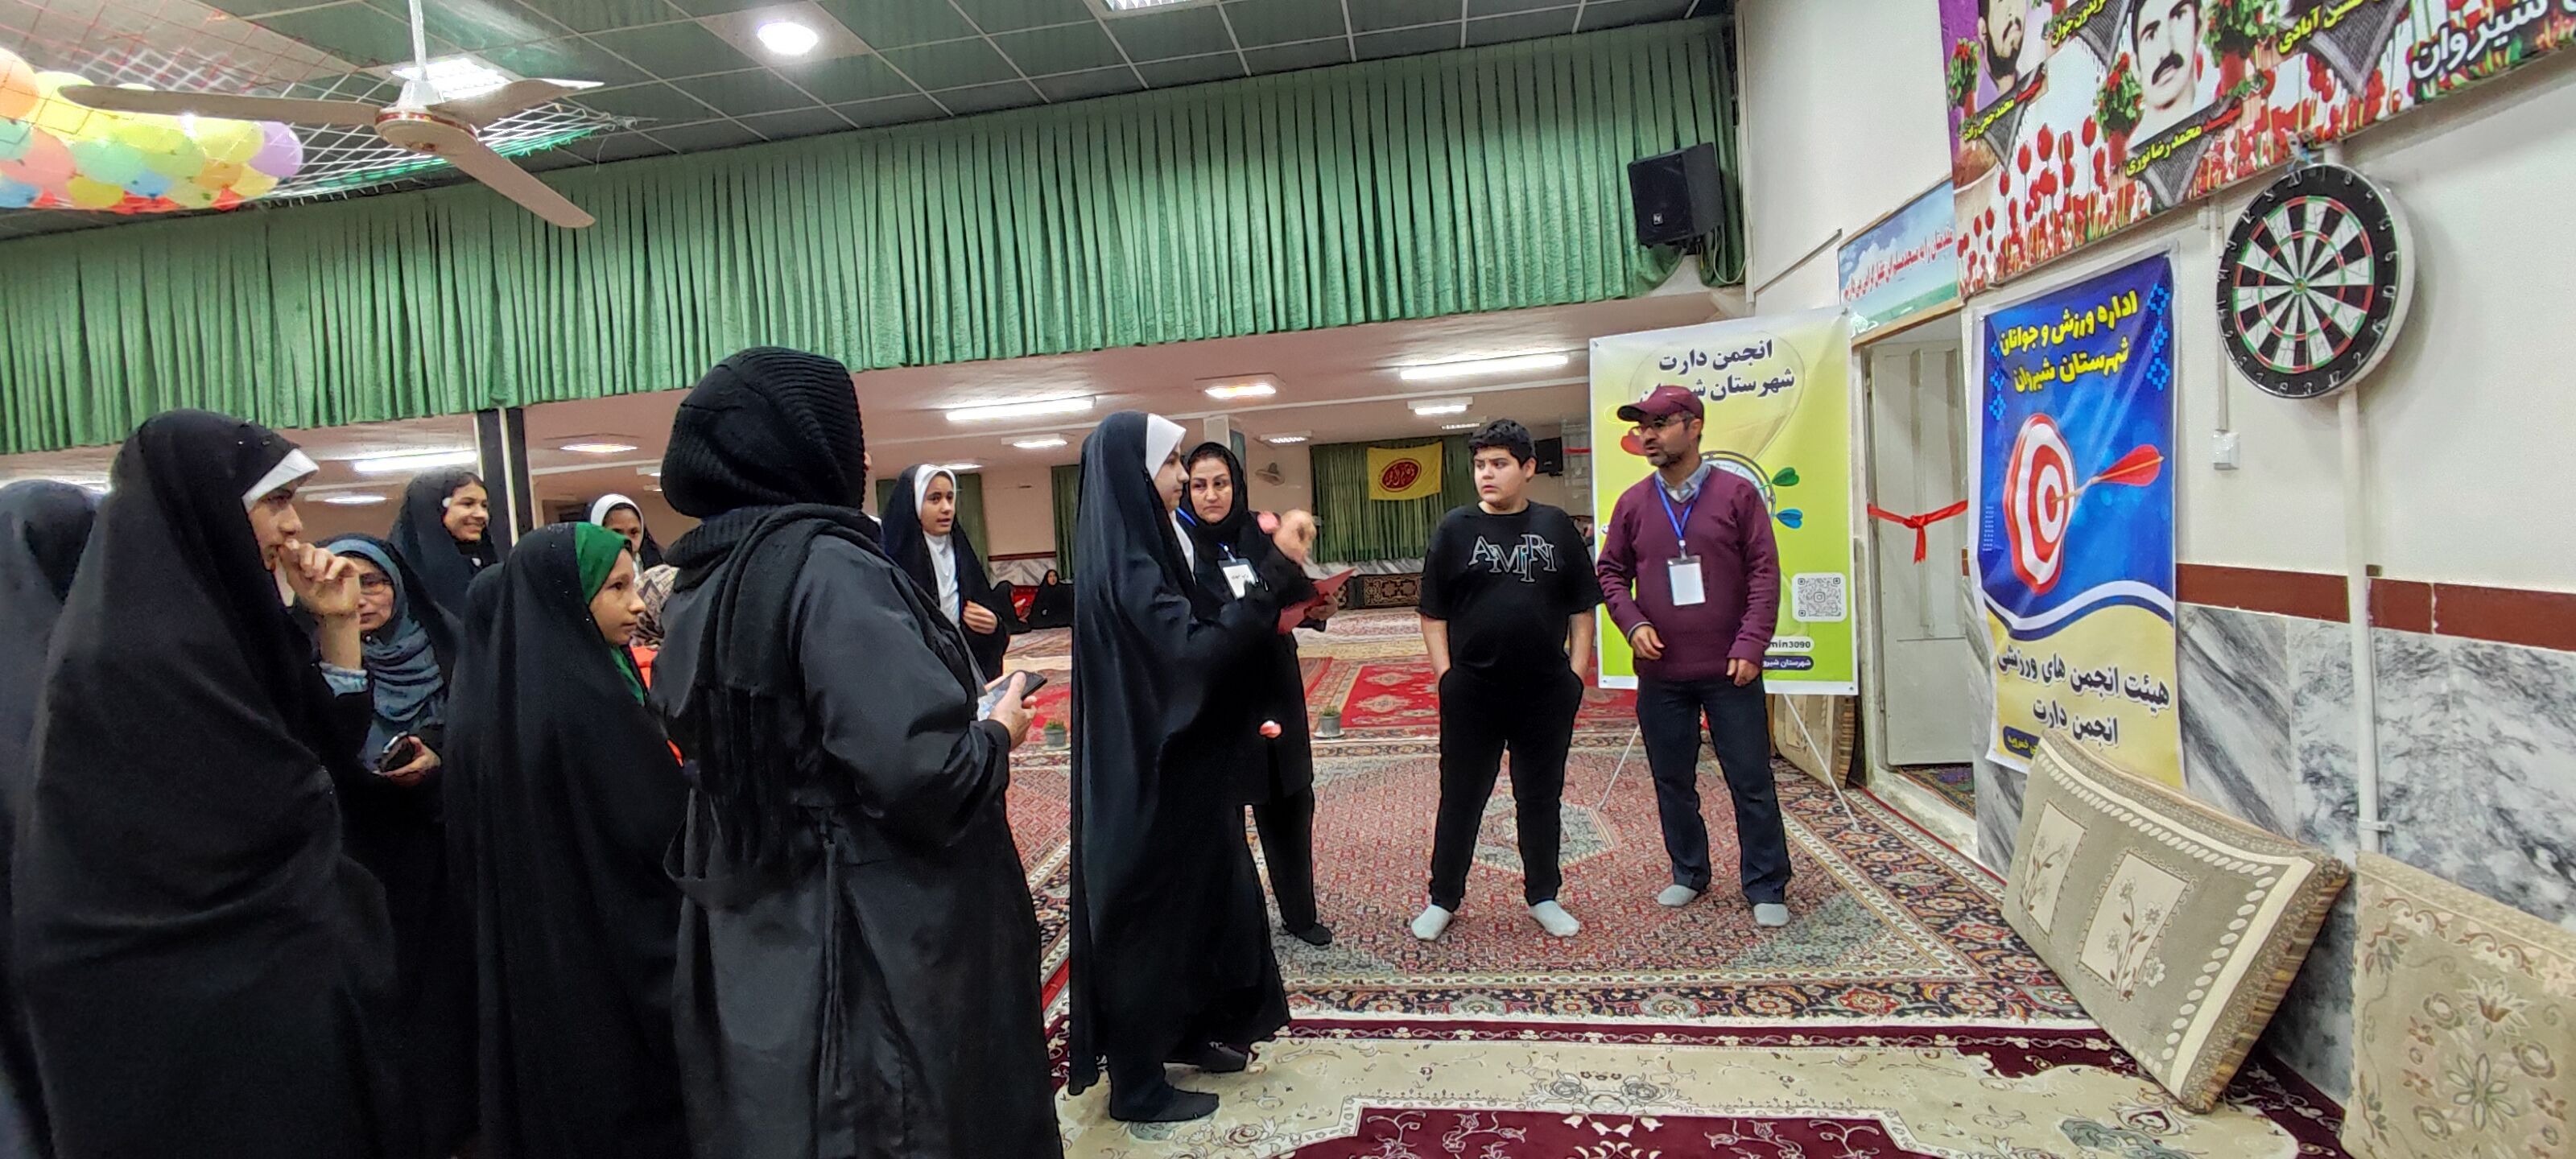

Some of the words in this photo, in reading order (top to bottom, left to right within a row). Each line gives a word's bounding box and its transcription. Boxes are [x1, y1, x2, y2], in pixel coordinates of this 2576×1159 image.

[2278, 4, 2322, 53] آبادی
[2171, 125, 2203, 150] محمد
[2097, 290, 2139, 329] اداره
[2000, 325, 2039, 357] جوانان
[2040, 324, 2050, 347] و
[2051, 308, 2095, 344] ورزش
[1658, 349, 1707, 376] دارت
[1712, 338, 1773, 371] انجمن
[2059, 336, 2129, 383] شهرستان
[1710, 368, 1795, 402] شهرستان
[2013, 357, 2056, 393] شیروان
[1762, 659, 1780, 667] شیرو
[1780, 658, 1811, 668] شهرستان
[1997, 645, 2038, 679] ورزشی
[2041, 653, 2066, 683] های
[2070, 667, 2119, 698] انجمن
[2124, 674, 2169, 713] هیئت
[2033, 700, 2067, 728] دارت
[2073, 716, 2118, 747] انجمن
